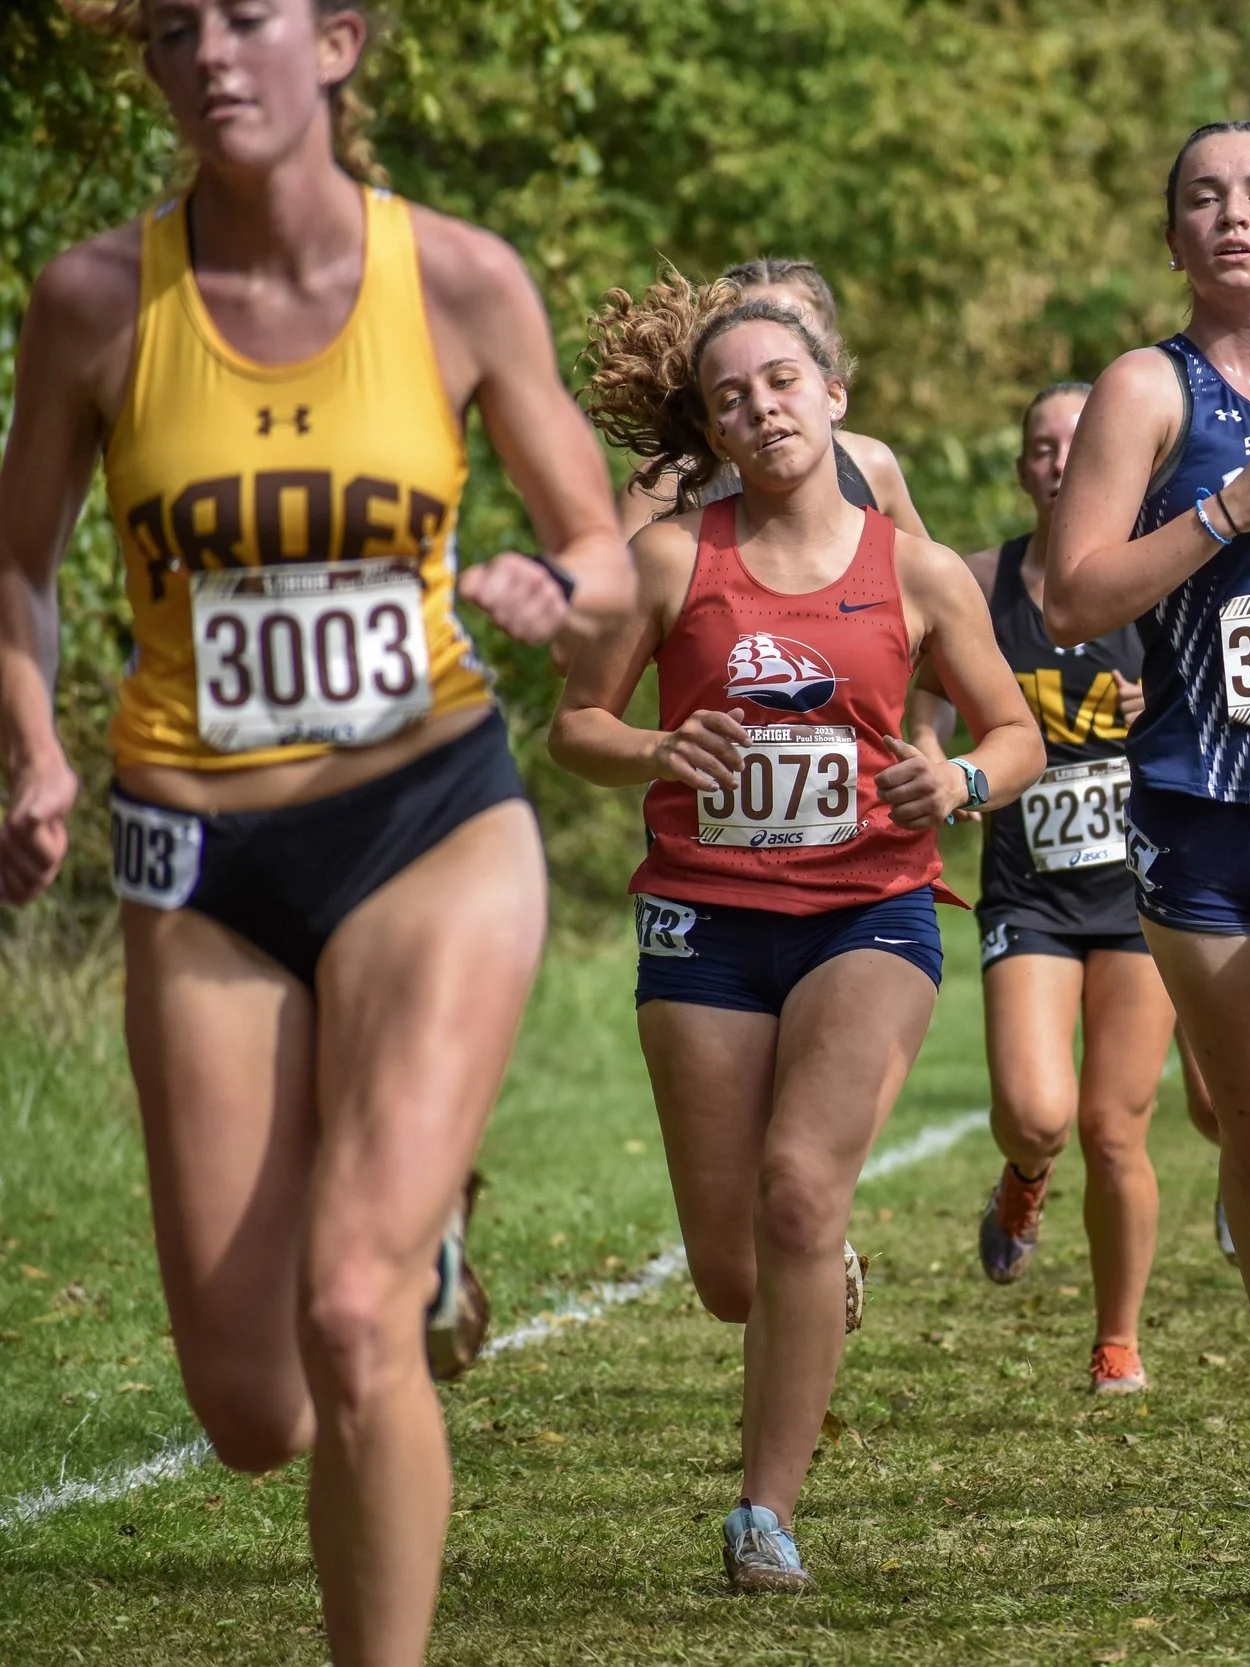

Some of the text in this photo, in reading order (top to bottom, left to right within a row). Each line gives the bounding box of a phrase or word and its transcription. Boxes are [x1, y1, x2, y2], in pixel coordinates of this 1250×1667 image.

[206, 602, 414, 709] 3003
[747, 729, 791, 742] LEHIGH
[815, 727, 834, 735] 2023
[703, 752, 850, 821] 3073
[1027, 781, 1132, 849] 2235
[767, 832, 803, 845] asics
